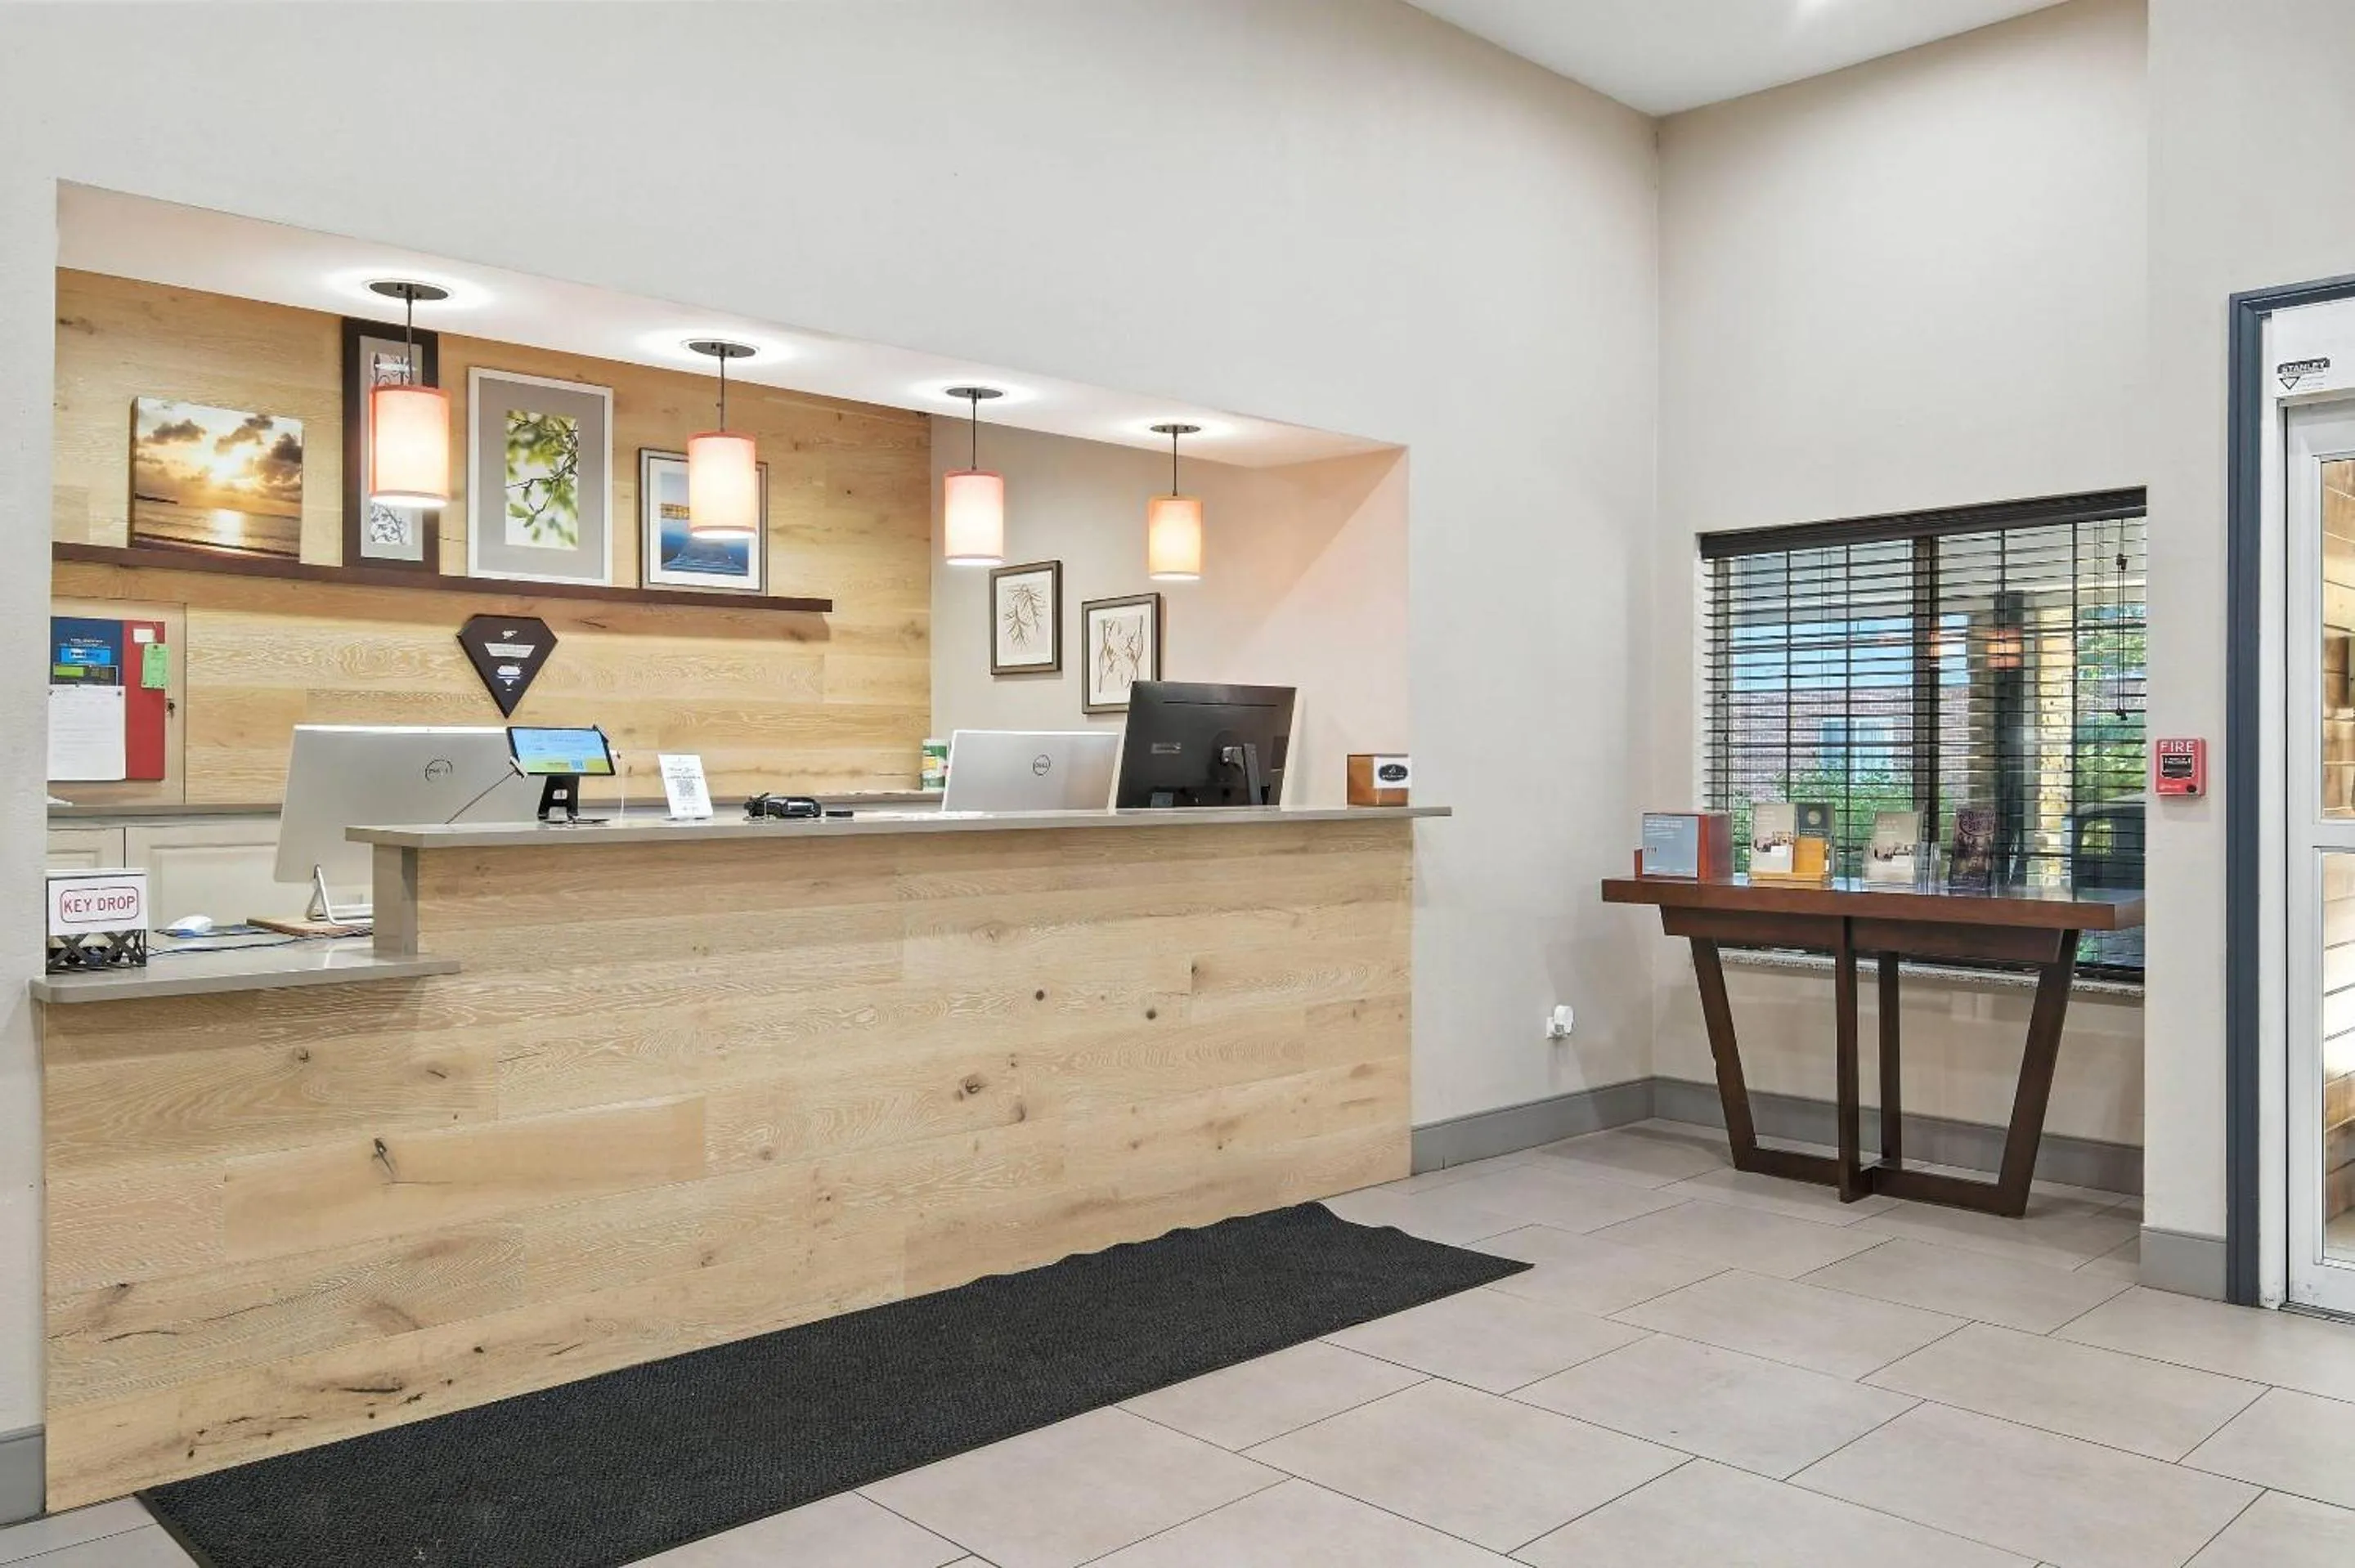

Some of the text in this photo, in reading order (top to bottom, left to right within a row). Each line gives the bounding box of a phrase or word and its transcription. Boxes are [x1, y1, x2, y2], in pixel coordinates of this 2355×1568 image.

[2160, 741, 2195, 752] FIRE
[64, 896, 136, 913] KEY DROP
